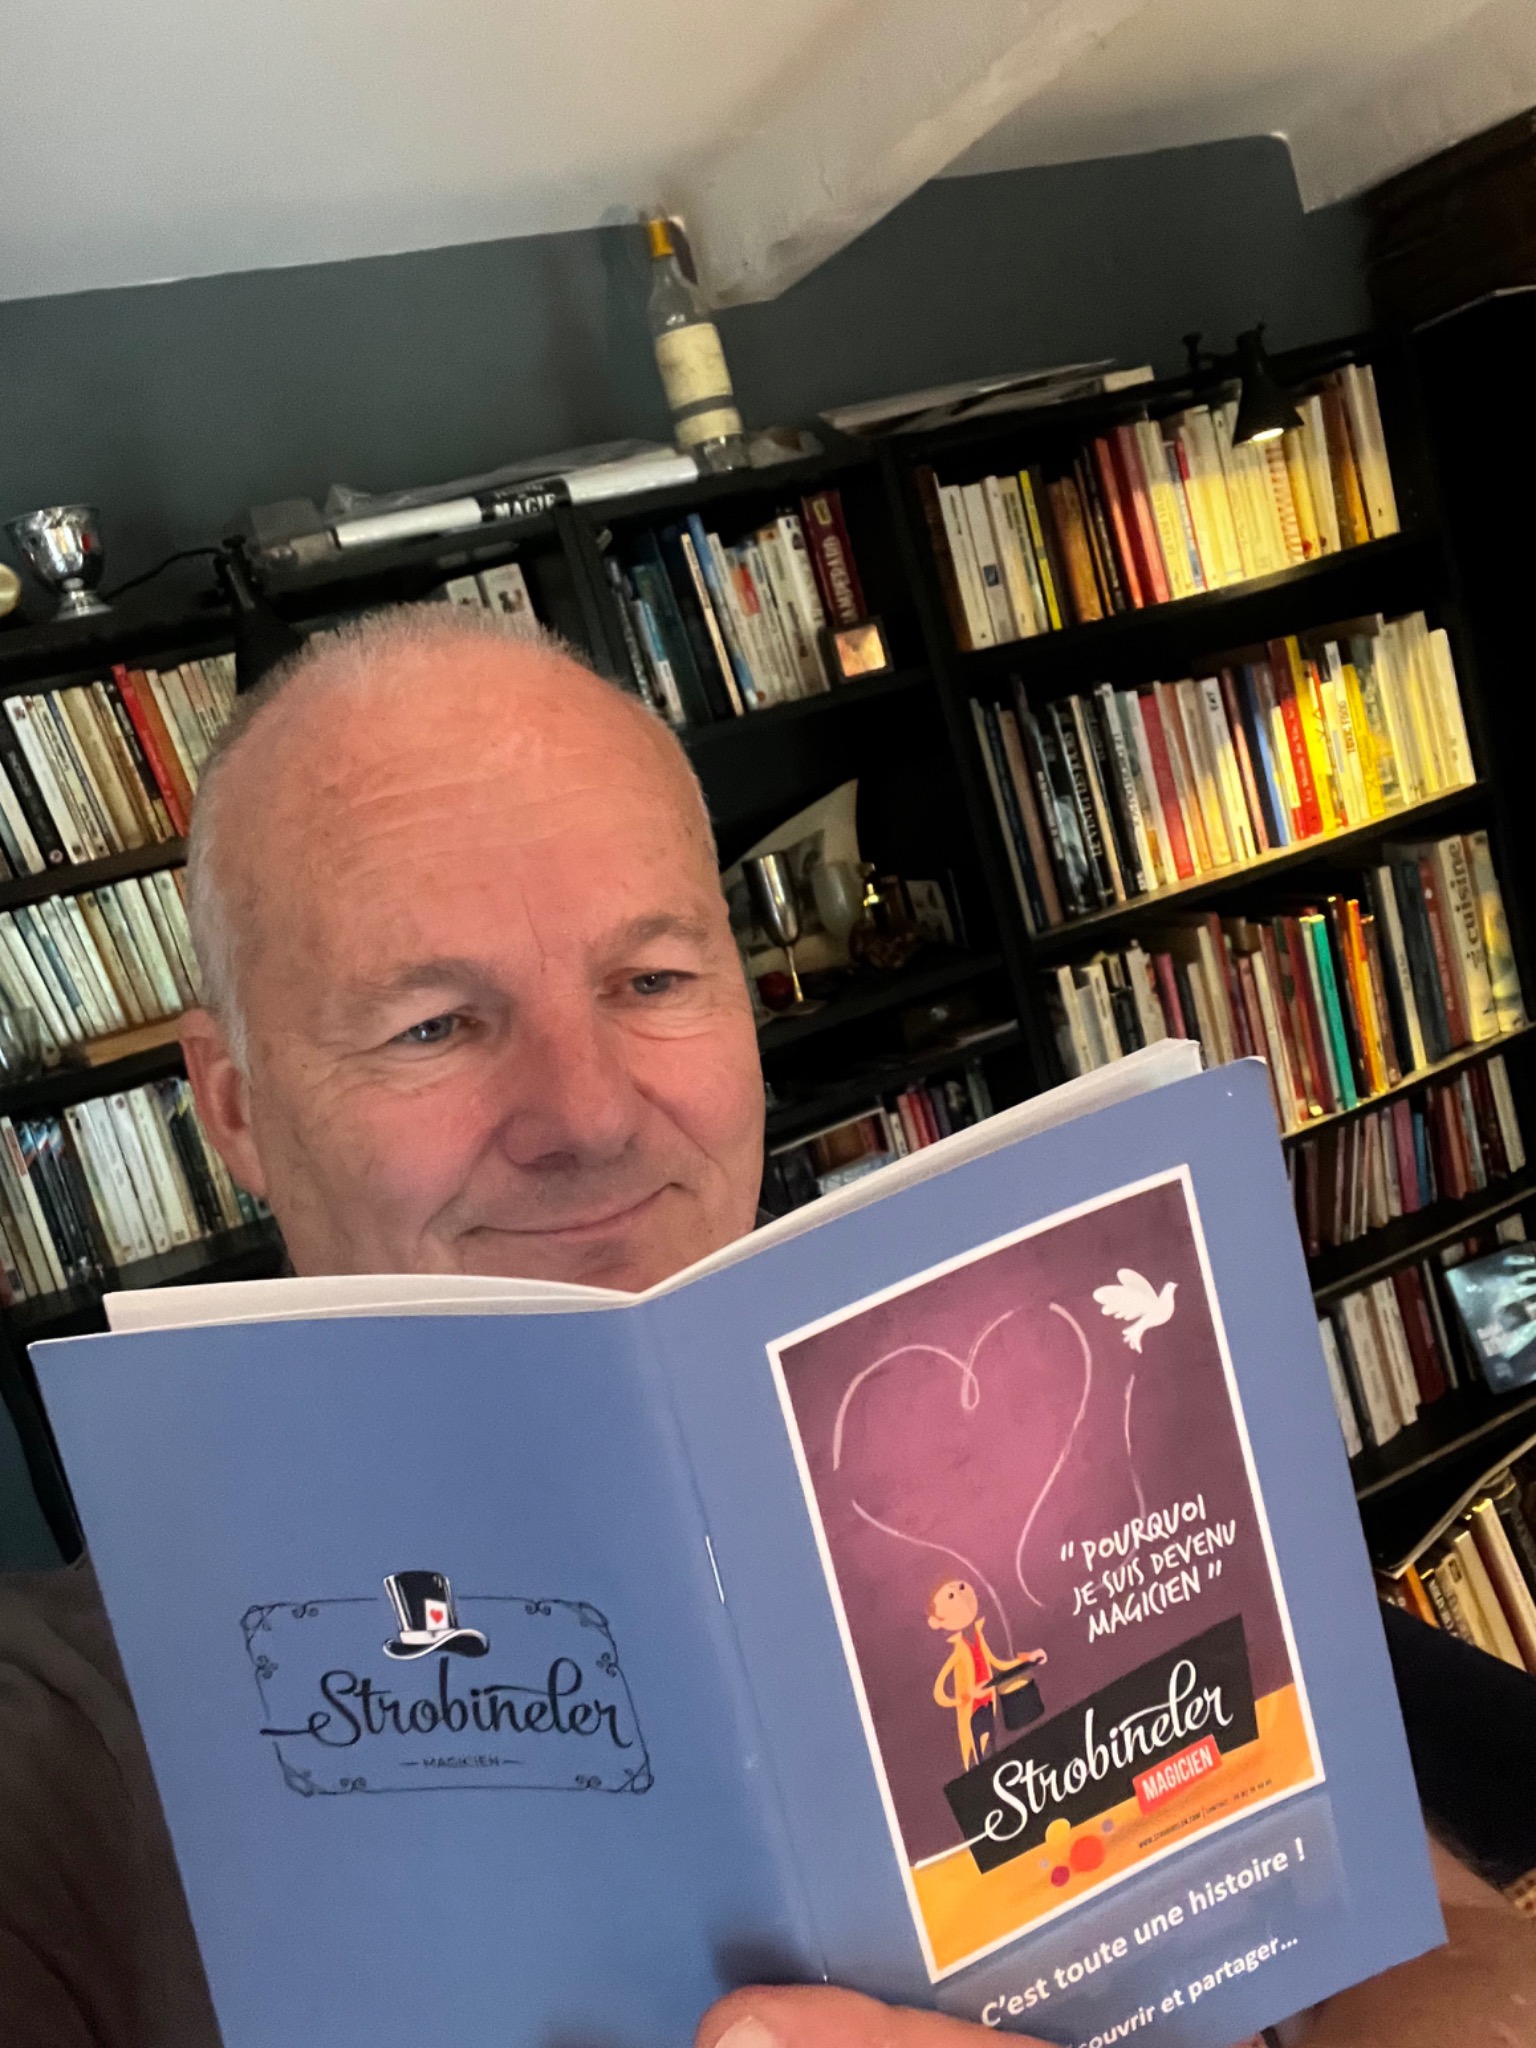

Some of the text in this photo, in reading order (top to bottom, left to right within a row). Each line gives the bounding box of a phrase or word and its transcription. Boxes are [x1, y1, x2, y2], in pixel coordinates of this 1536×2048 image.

[1448, 842, 1482, 946] cuisine
[1073, 1519, 1236, 1616] JE SUIS DEVENU
[1081, 1493, 1206, 1572] POURQUOI
[1089, 1565, 1201, 1643] MAGICIEN
[260, 1657, 633, 1748] Strobineler
[915, 1659, 1233, 1869] Strobineler
[1141, 1745, 1214, 1802] MAGICIEN
[981, 1978, 1050, 2028] C'est
[1054, 1936, 1129, 1989] toute
[1133, 1905, 1184, 1946] une
[1189, 1849, 1289, 1915] histoire
[1161, 1989, 1184, 2014] et
